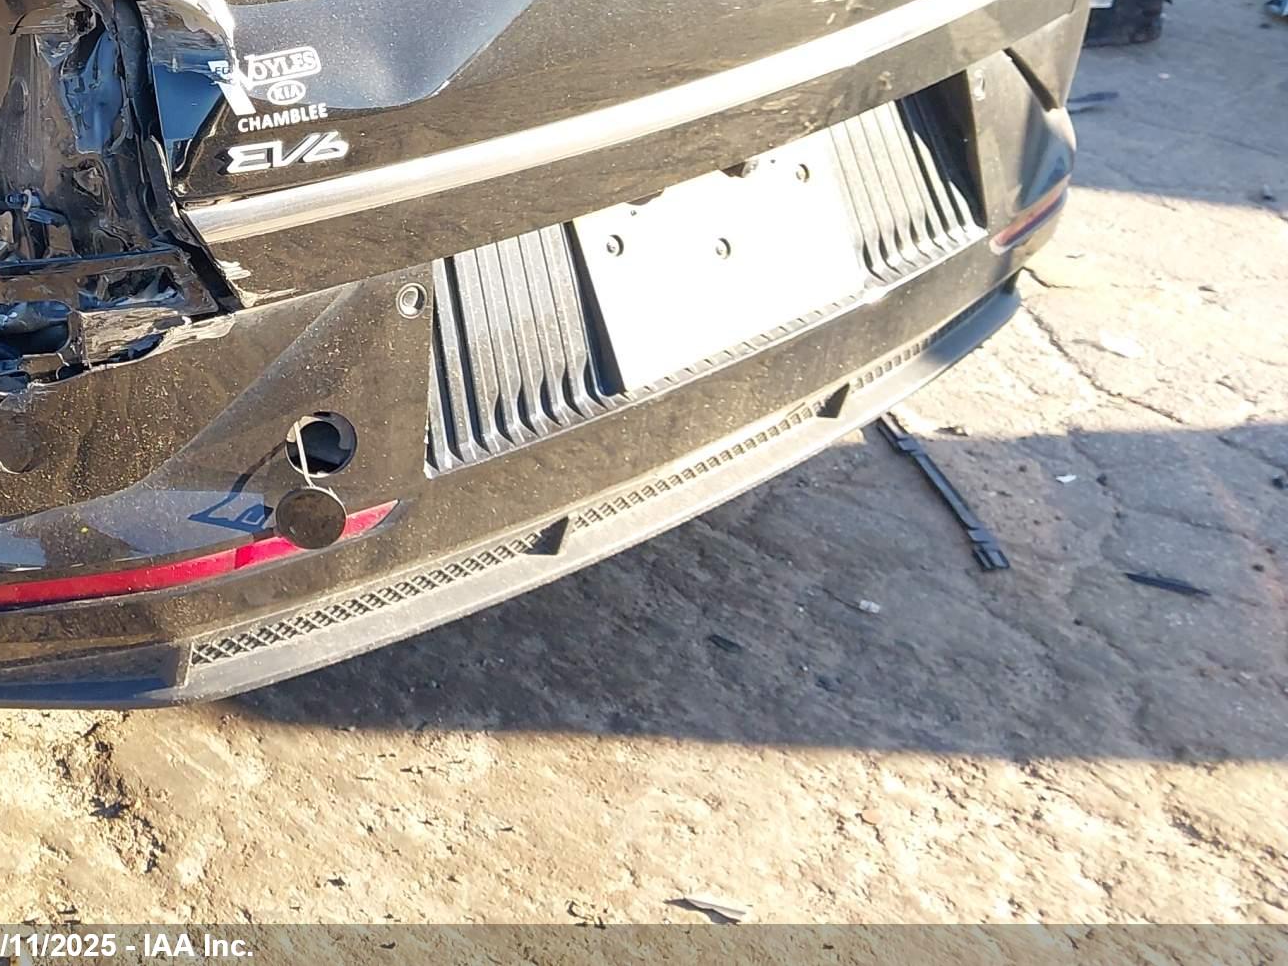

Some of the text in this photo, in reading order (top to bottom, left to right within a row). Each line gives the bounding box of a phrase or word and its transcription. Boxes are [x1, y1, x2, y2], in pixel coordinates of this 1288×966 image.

[273, 84, 300, 101] KIA
[237, 103, 329, 133] CHAMBLEE
[226, 131, 350, 174] EV6
